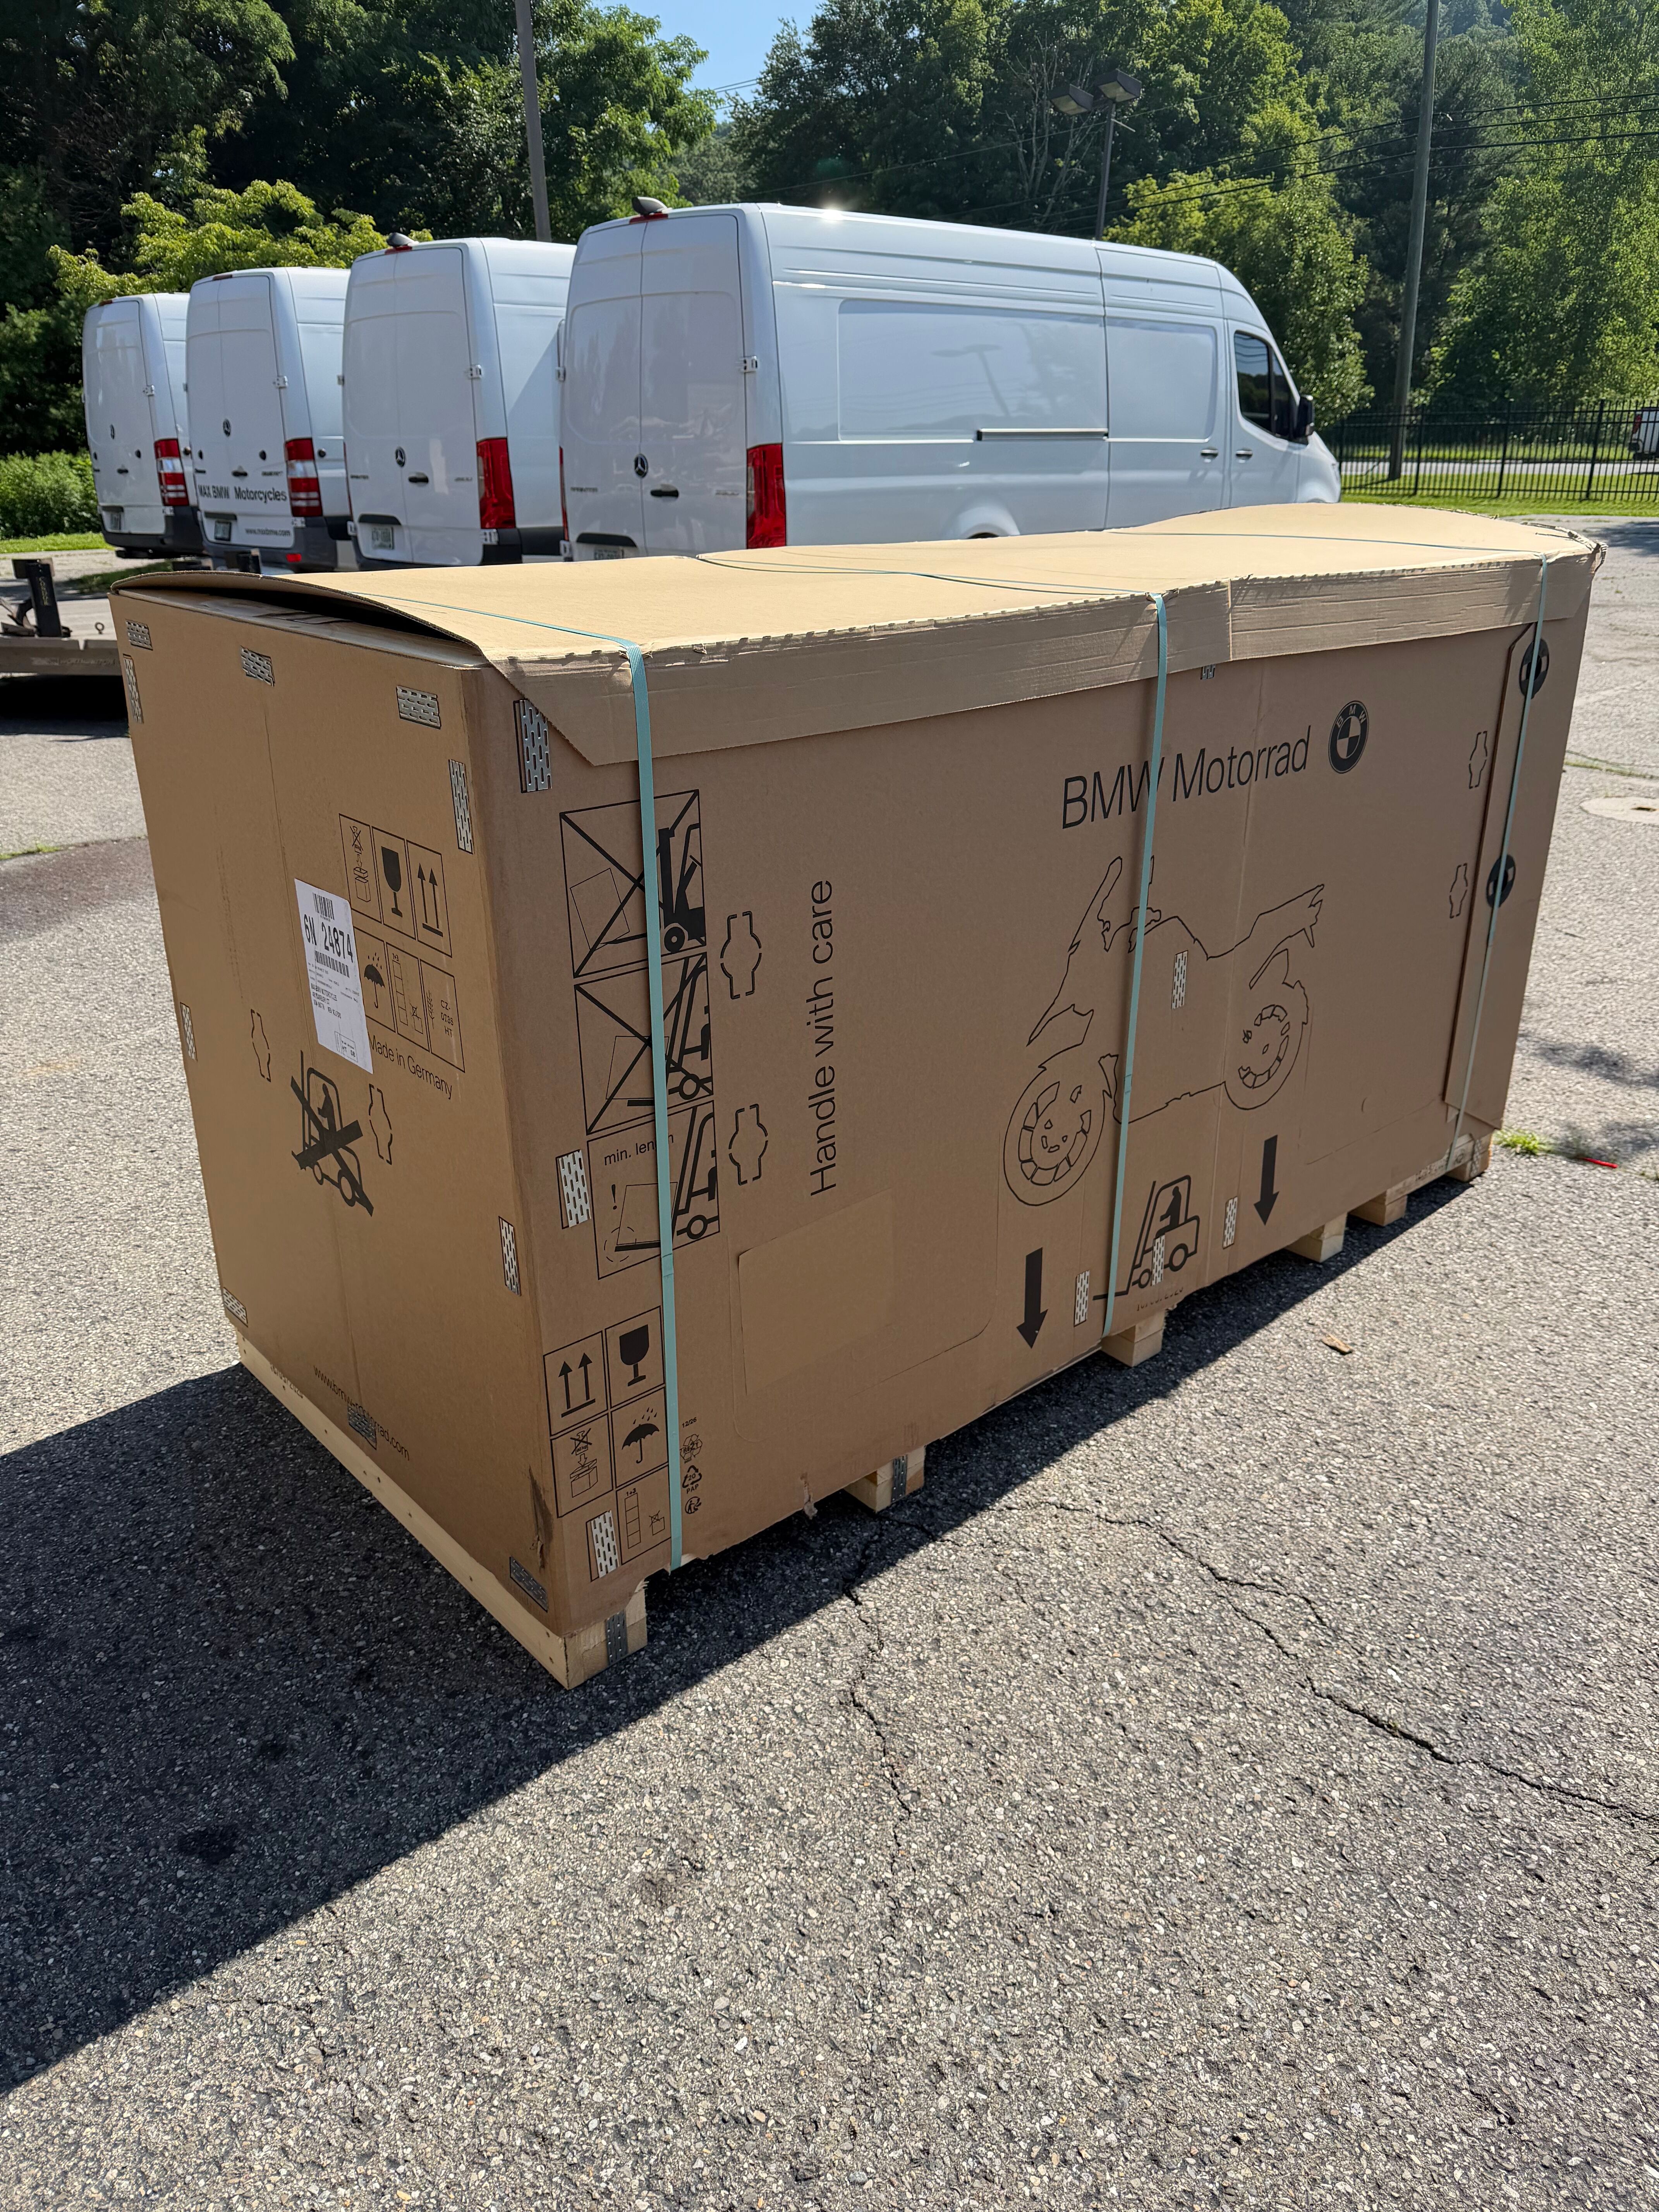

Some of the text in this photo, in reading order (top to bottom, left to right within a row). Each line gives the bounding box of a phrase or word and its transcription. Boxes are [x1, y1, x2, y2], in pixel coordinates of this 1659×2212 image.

[198, 484, 287, 503] MAX BMW Motorcycles
[1336, 704, 1366, 728] BMW
[1062, 725, 1311, 829] BMW Motorrad
[304, 914, 353, 963] 6N 24874
[444, 1025, 452, 1037] HT
[806, 880, 836, 1196] Handle with care
[368, 1032, 452, 1100] Made in Germany
[605, 1149, 631, 1166] min.
[682, 1417, 697, 1428] 12/26
[687, 1484, 699, 1494] PAP
